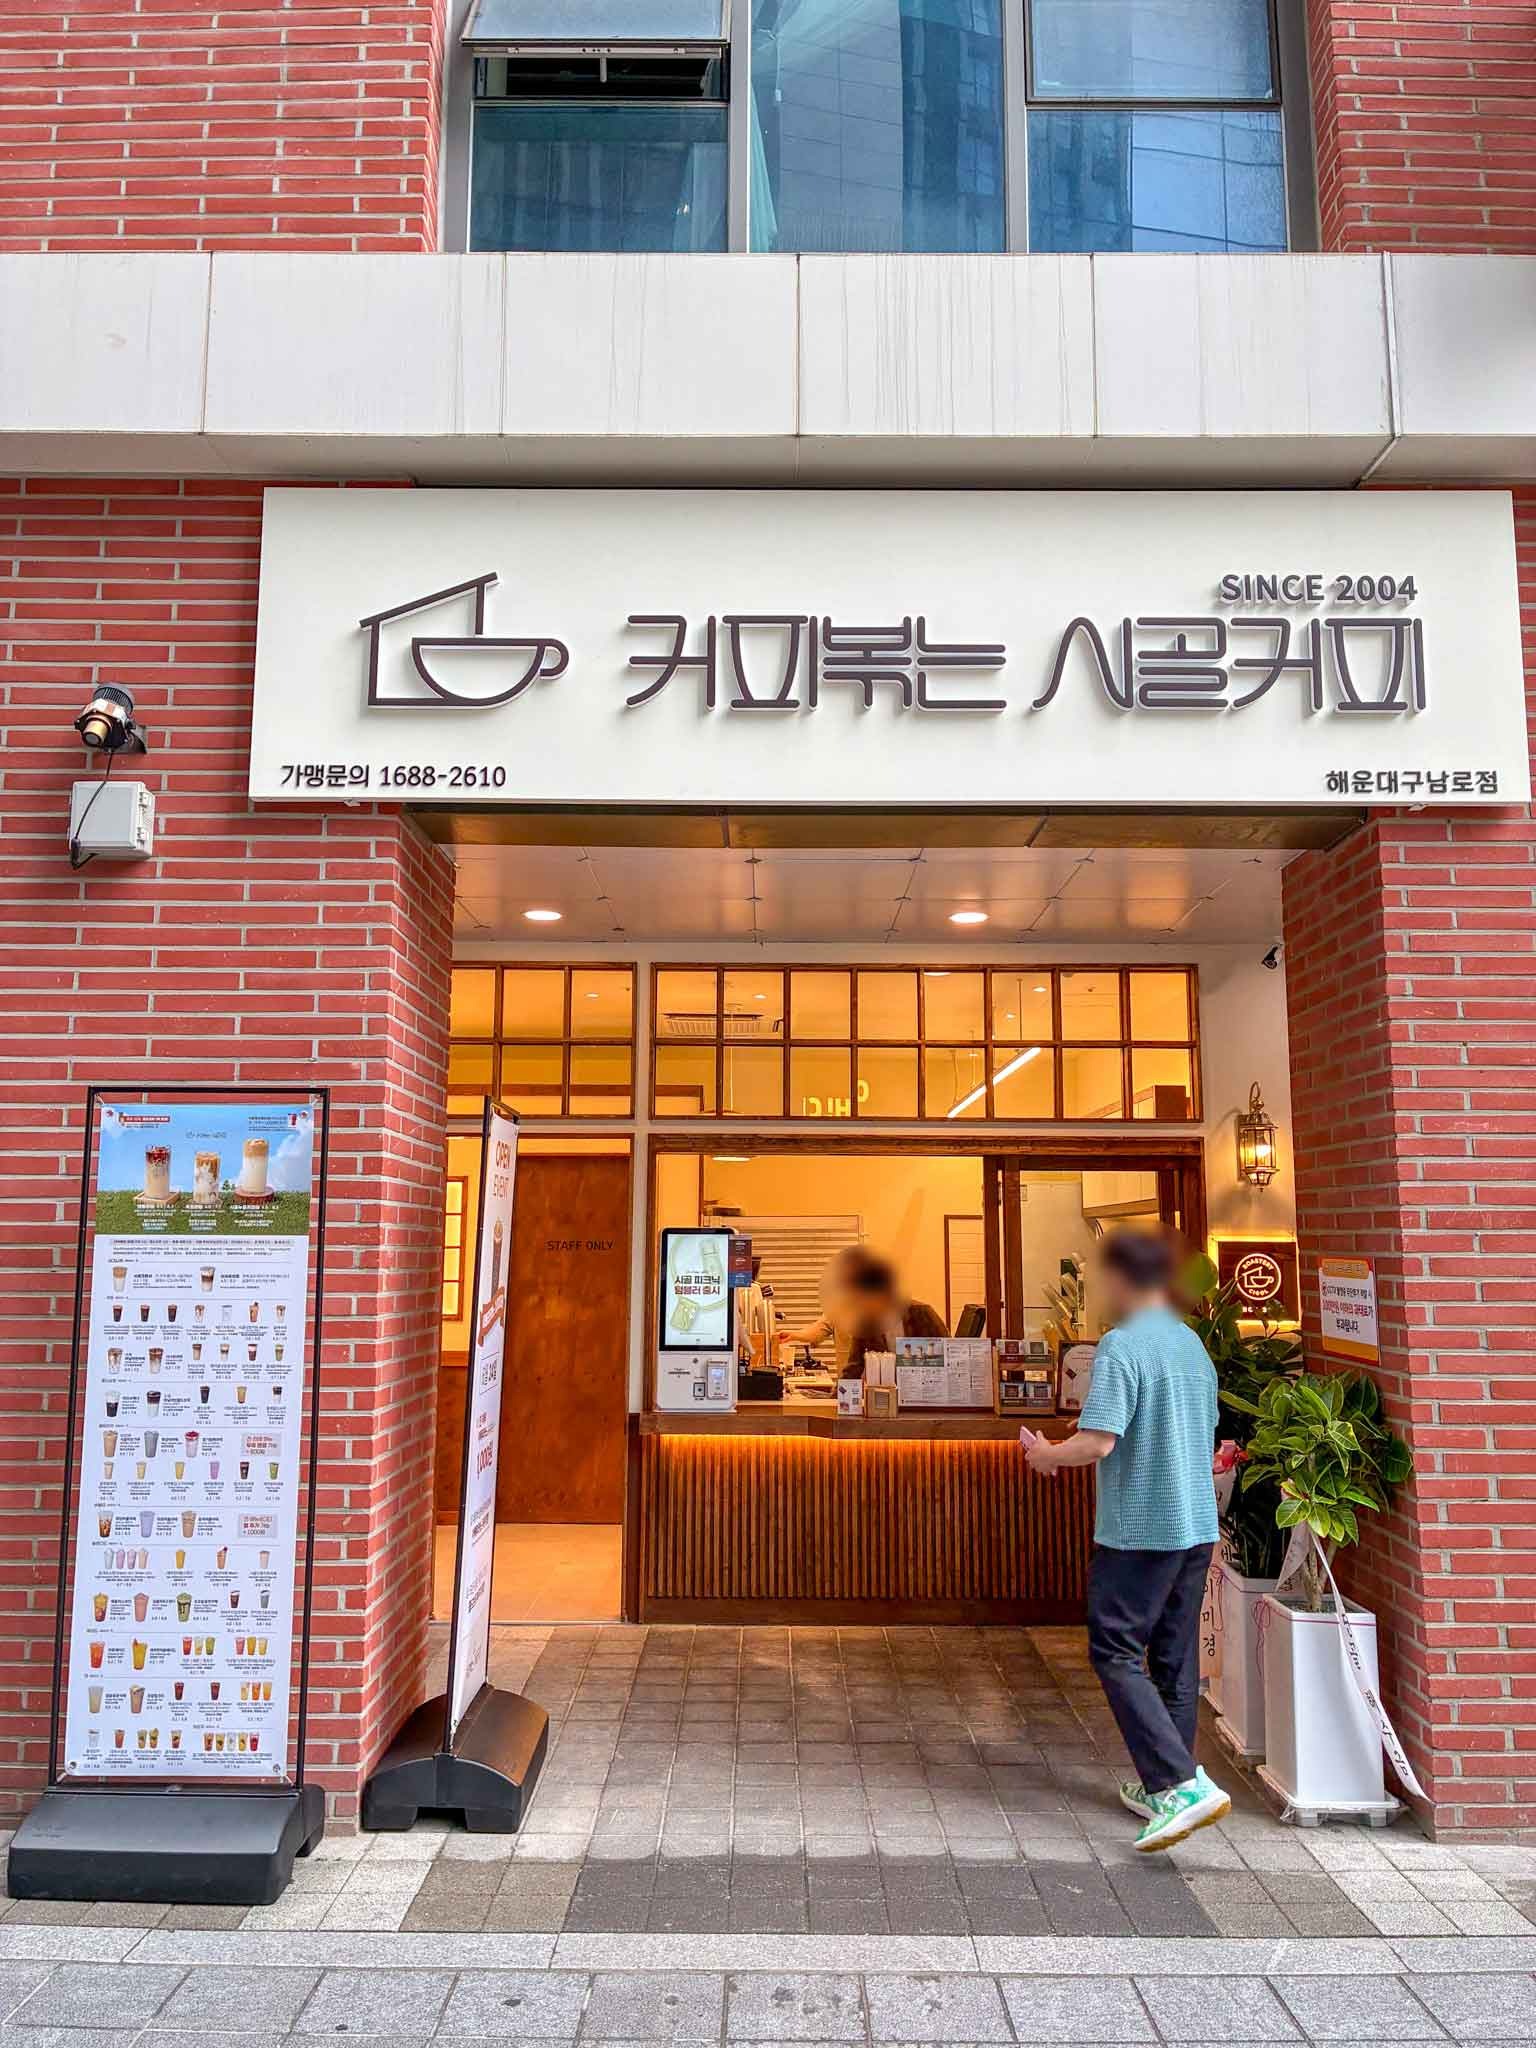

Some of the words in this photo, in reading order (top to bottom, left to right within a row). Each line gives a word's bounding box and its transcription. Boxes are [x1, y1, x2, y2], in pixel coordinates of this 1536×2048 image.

[1221, 574, 1324, 601] SINCE
[1336, 575, 1417, 602] 2004
[627, 614, 1006, 711] 커피볶는
[1031, 616, 1426, 712] 시골커피
[281, 765, 370, 788] 가맹문의
[380, 766, 506, 787] 1688-2610
[1326, 770, 1499, 794] 해운대구남로점
[494, 1140, 511, 1169] OPEN
[546, 1240, 582, 1251] STAFF
[585, 1240, 614, 1251] ONLY
[1242, 1258, 1274, 1270] ROASTERY
[674, 1275, 692, 1284] 시골
[694, 1275, 720, 1285] 피크닉
